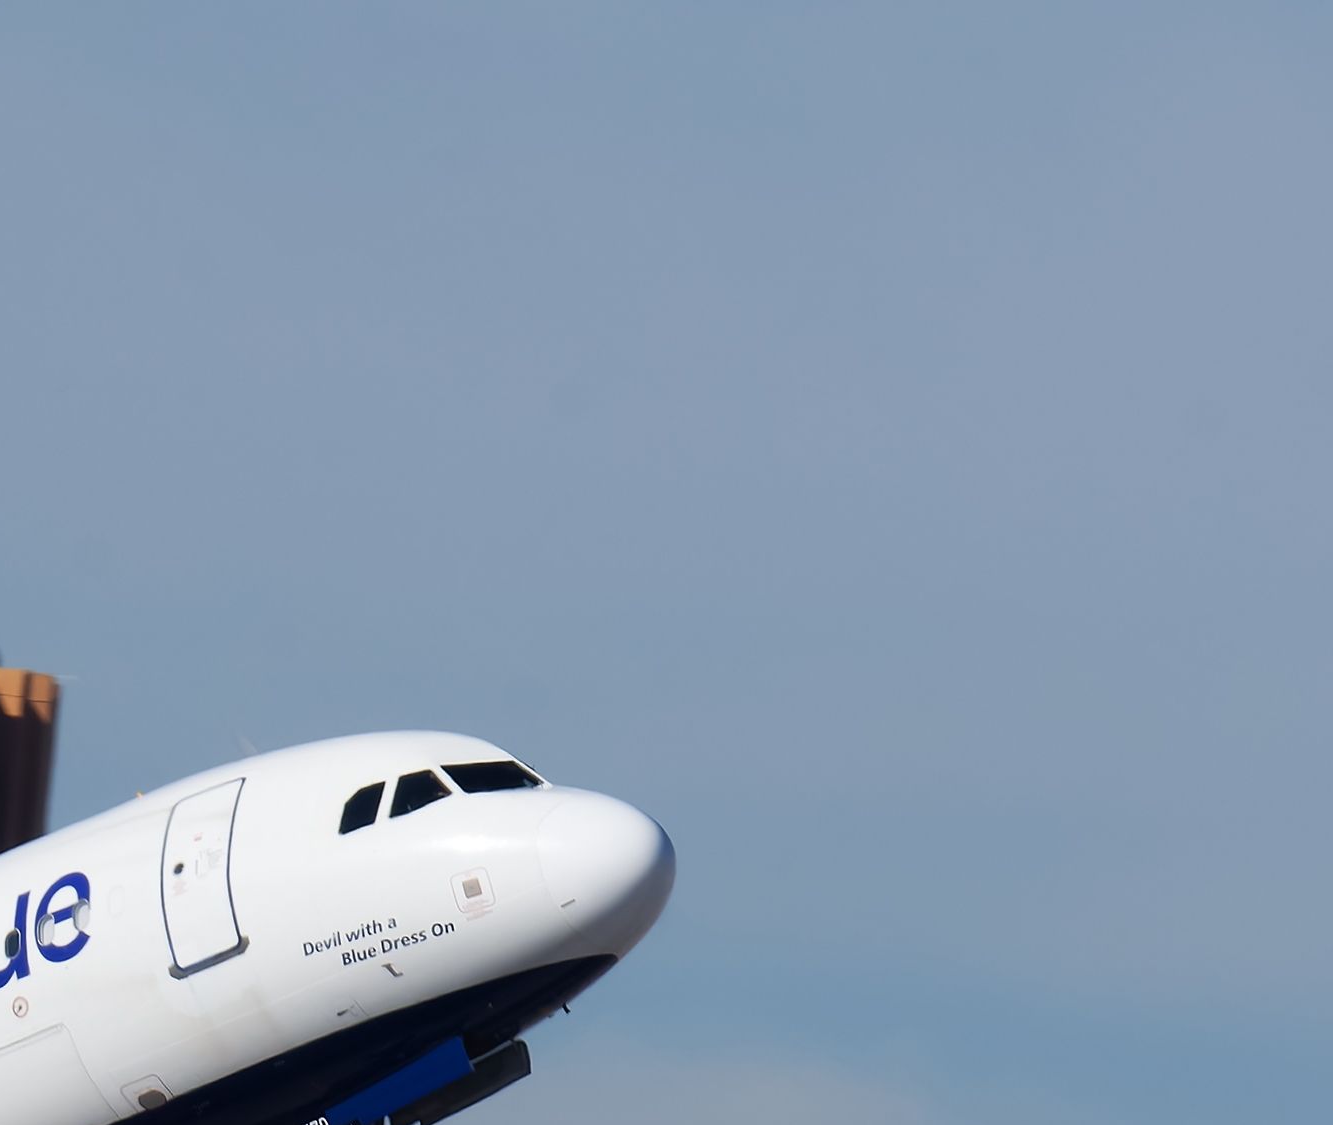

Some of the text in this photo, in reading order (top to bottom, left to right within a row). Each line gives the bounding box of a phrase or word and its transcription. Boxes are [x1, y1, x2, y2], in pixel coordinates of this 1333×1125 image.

[302, 917, 398, 957] Devil with a
[341, 921, 456, 966] Blue Dress On
